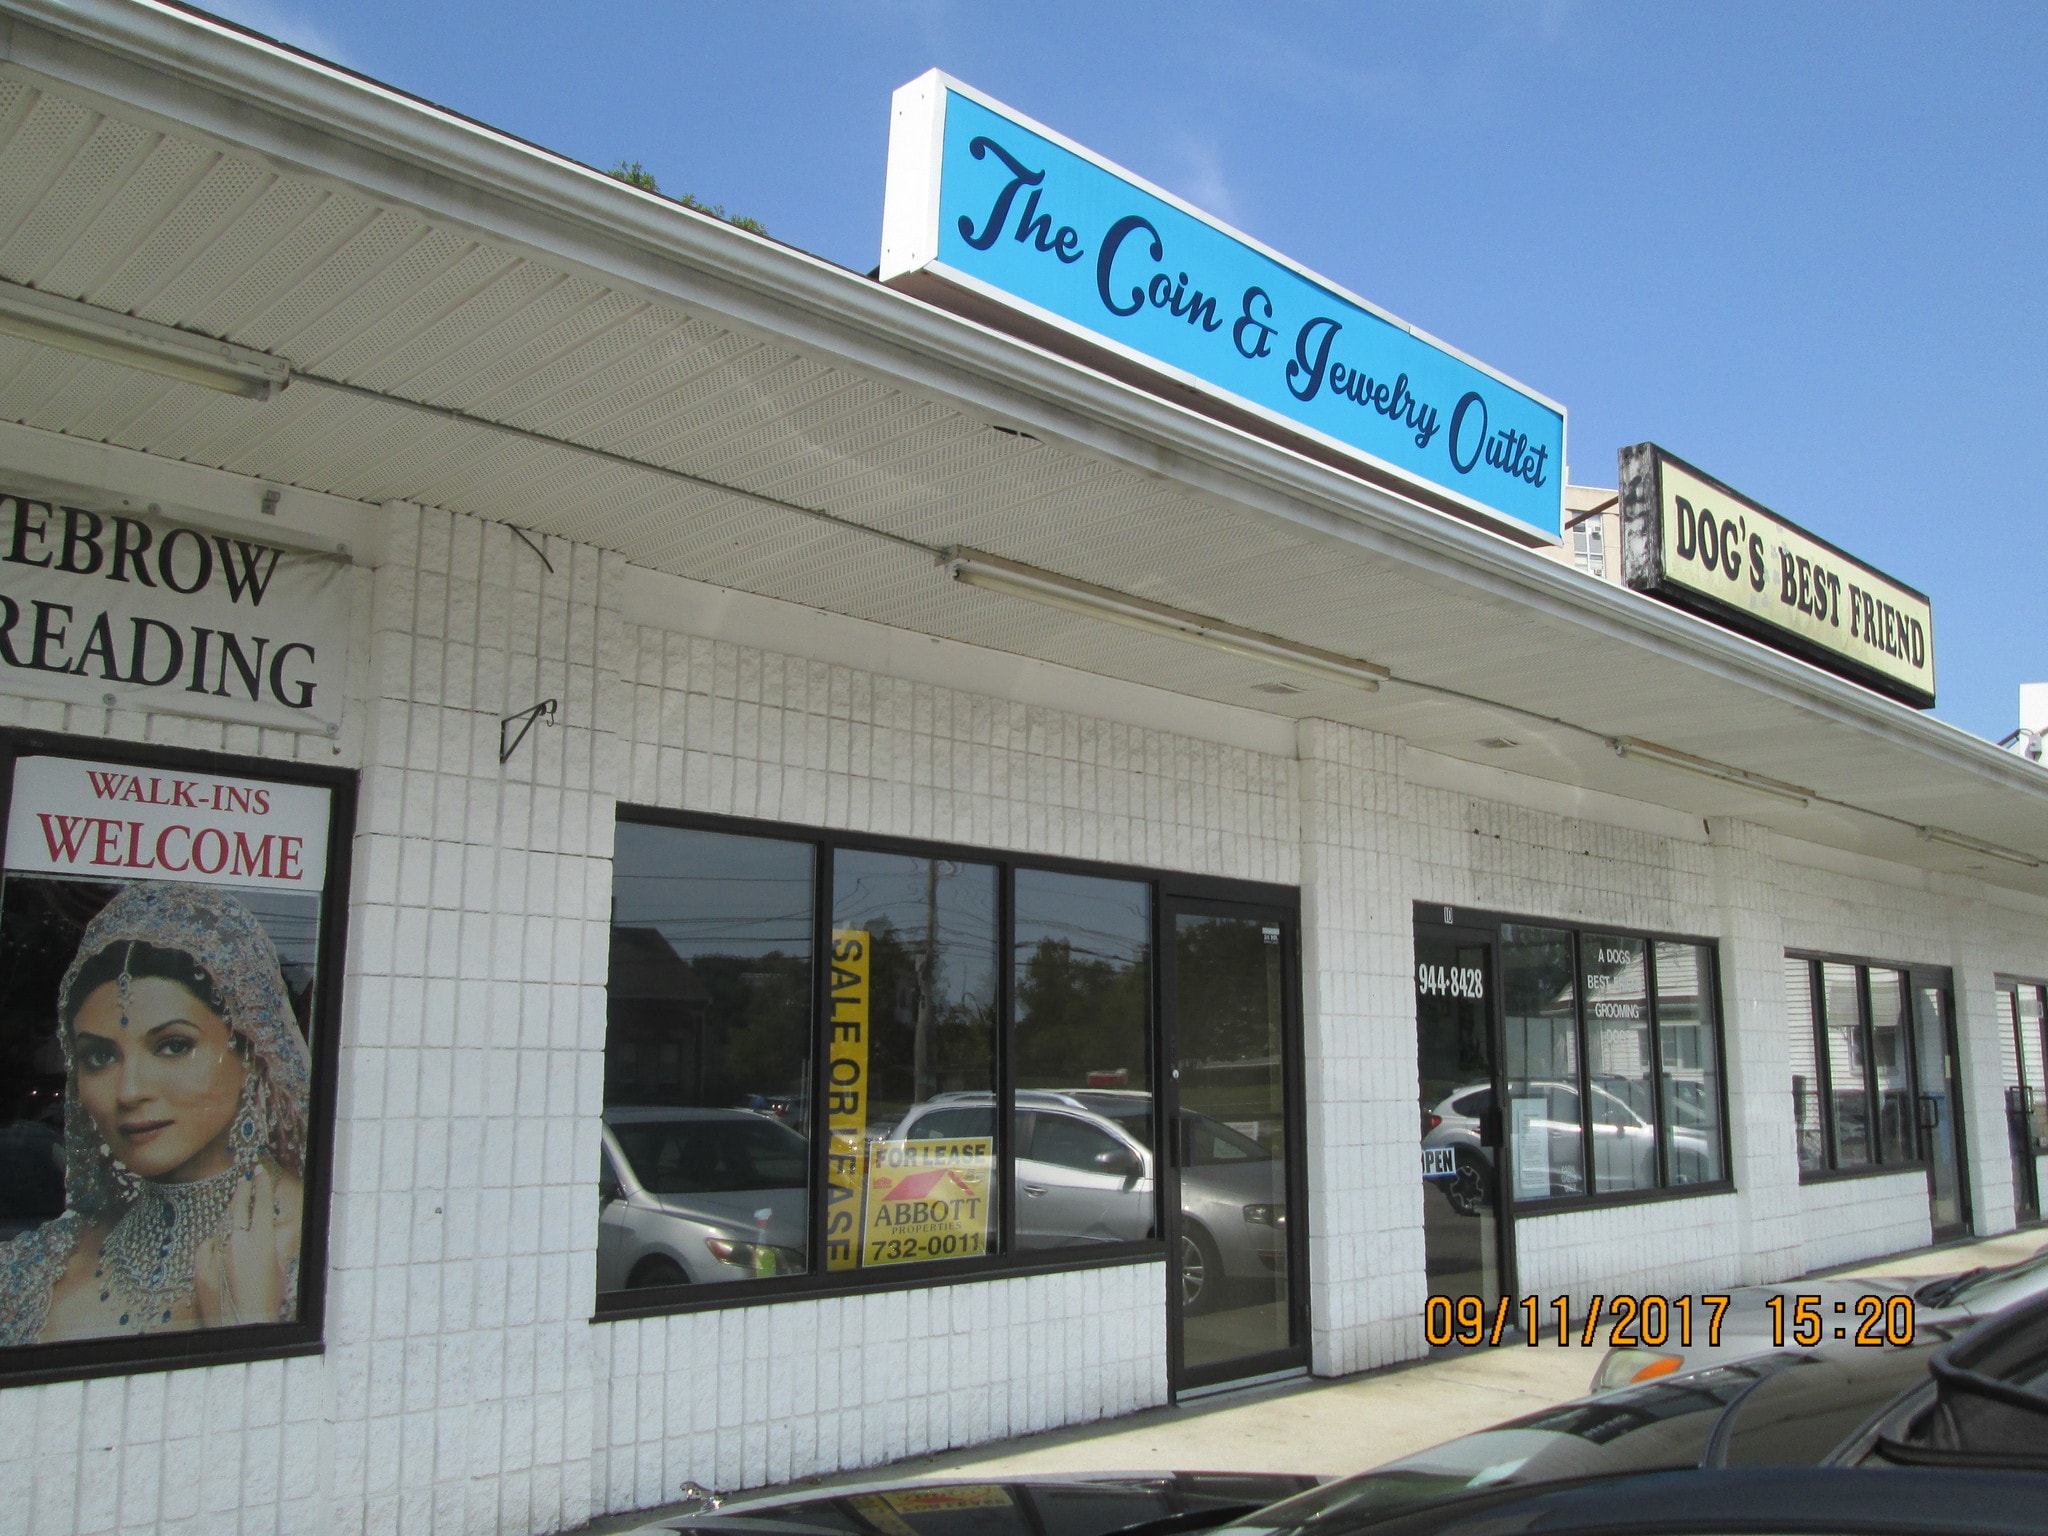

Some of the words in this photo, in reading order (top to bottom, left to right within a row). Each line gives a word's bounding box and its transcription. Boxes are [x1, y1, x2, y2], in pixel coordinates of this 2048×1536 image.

[957, 135, 1084, 264] The
[1096, 215, 1223, 333] Coin
[1232, 286, 1279, 359] &
[1285, 316, 1441, 449] Jewelry
[1448, 391, 1549, 489] Outlet
[0, 493, 286, 607] EBROW
[1675, 494, 1765, 593] DOG'S
[1778, 546, 1842, 627] BEST
[1848, 583, 1925, 670] FRIEND
[86, 770, 271, 816] WALK-INS
[37, 812, 305, 881] WELCOME
[1598, 949, 1605, 963] A
[1606, 949, 1631, 964] DOGS
[830, 938, 864, 1043] SALE
[1587, 975, 1610, 989] BEST
[1595, 1003, 1640, 1018] GROOMING
[828, 1058, 861, 1115] OR
[876, 1146, 918, 1168] FOR
[922, 1144, 987, 1166] LEASE
[826, 1128, 858, 1261] LEASE
[873, 1197, 982, 1228] ABBOTT
[871, 1232, 980, 1261] 732-0011
[891, 1222, 962, 1235] PROPERTIES
